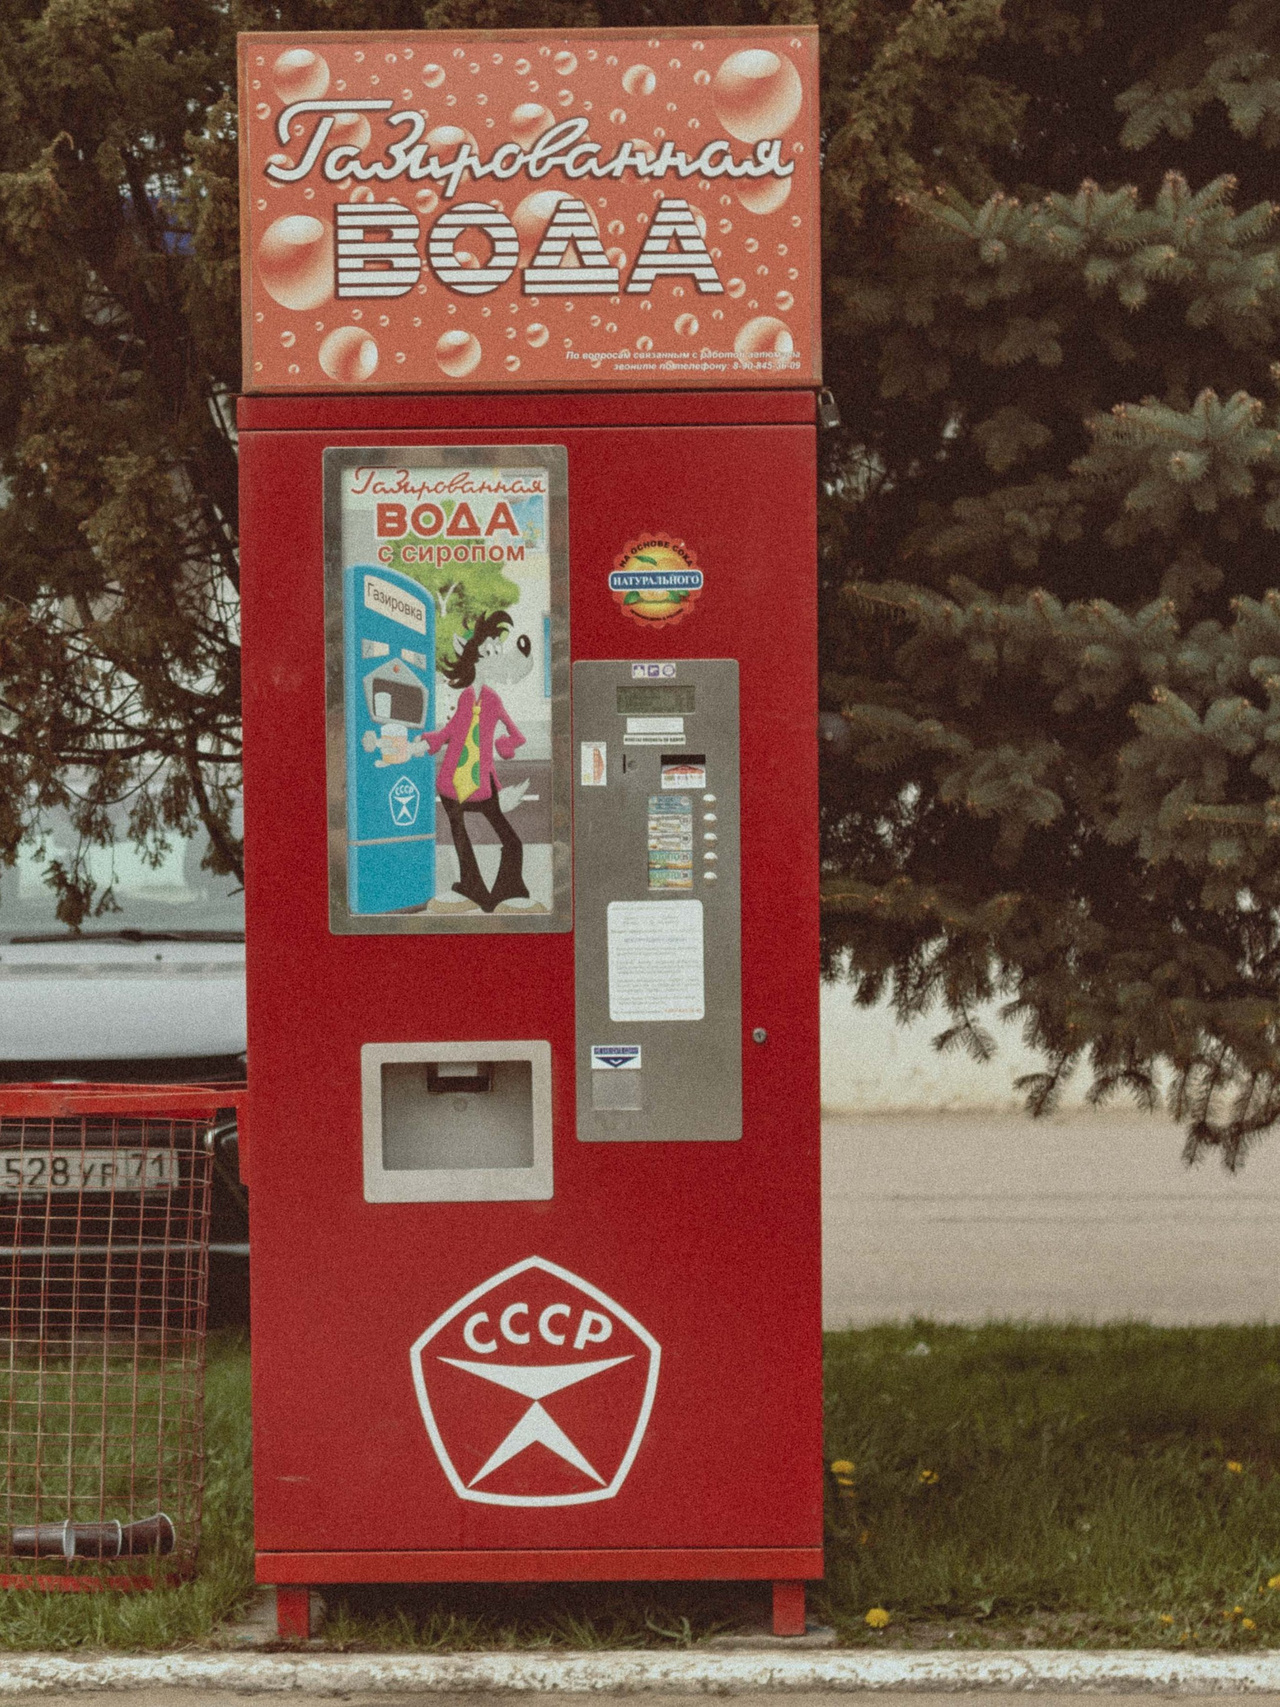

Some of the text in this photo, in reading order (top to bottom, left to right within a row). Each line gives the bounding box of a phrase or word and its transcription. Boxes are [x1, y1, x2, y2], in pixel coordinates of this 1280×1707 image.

[265, 98, 796, 199] Газированная
[334, 198, 726, 300] ВОДА
[566, 351, 580, 359] По
[748, 351, 801, 359] автома
[351, 466, 546, 500] Газированная
[376, 502, 520, 538] ВОДА
[377, 545, 525, 567] с сиропом
[620, 540, 693, 568] НА ОСНОВЕ СОКА
[613, 575, 700, 586] НАТУРАЛЬНОГО
[367, 582, 423, 621] Газировка
[131, 1153, 165, 1177] 71
[463, 1302, 613, 1353] СССР
